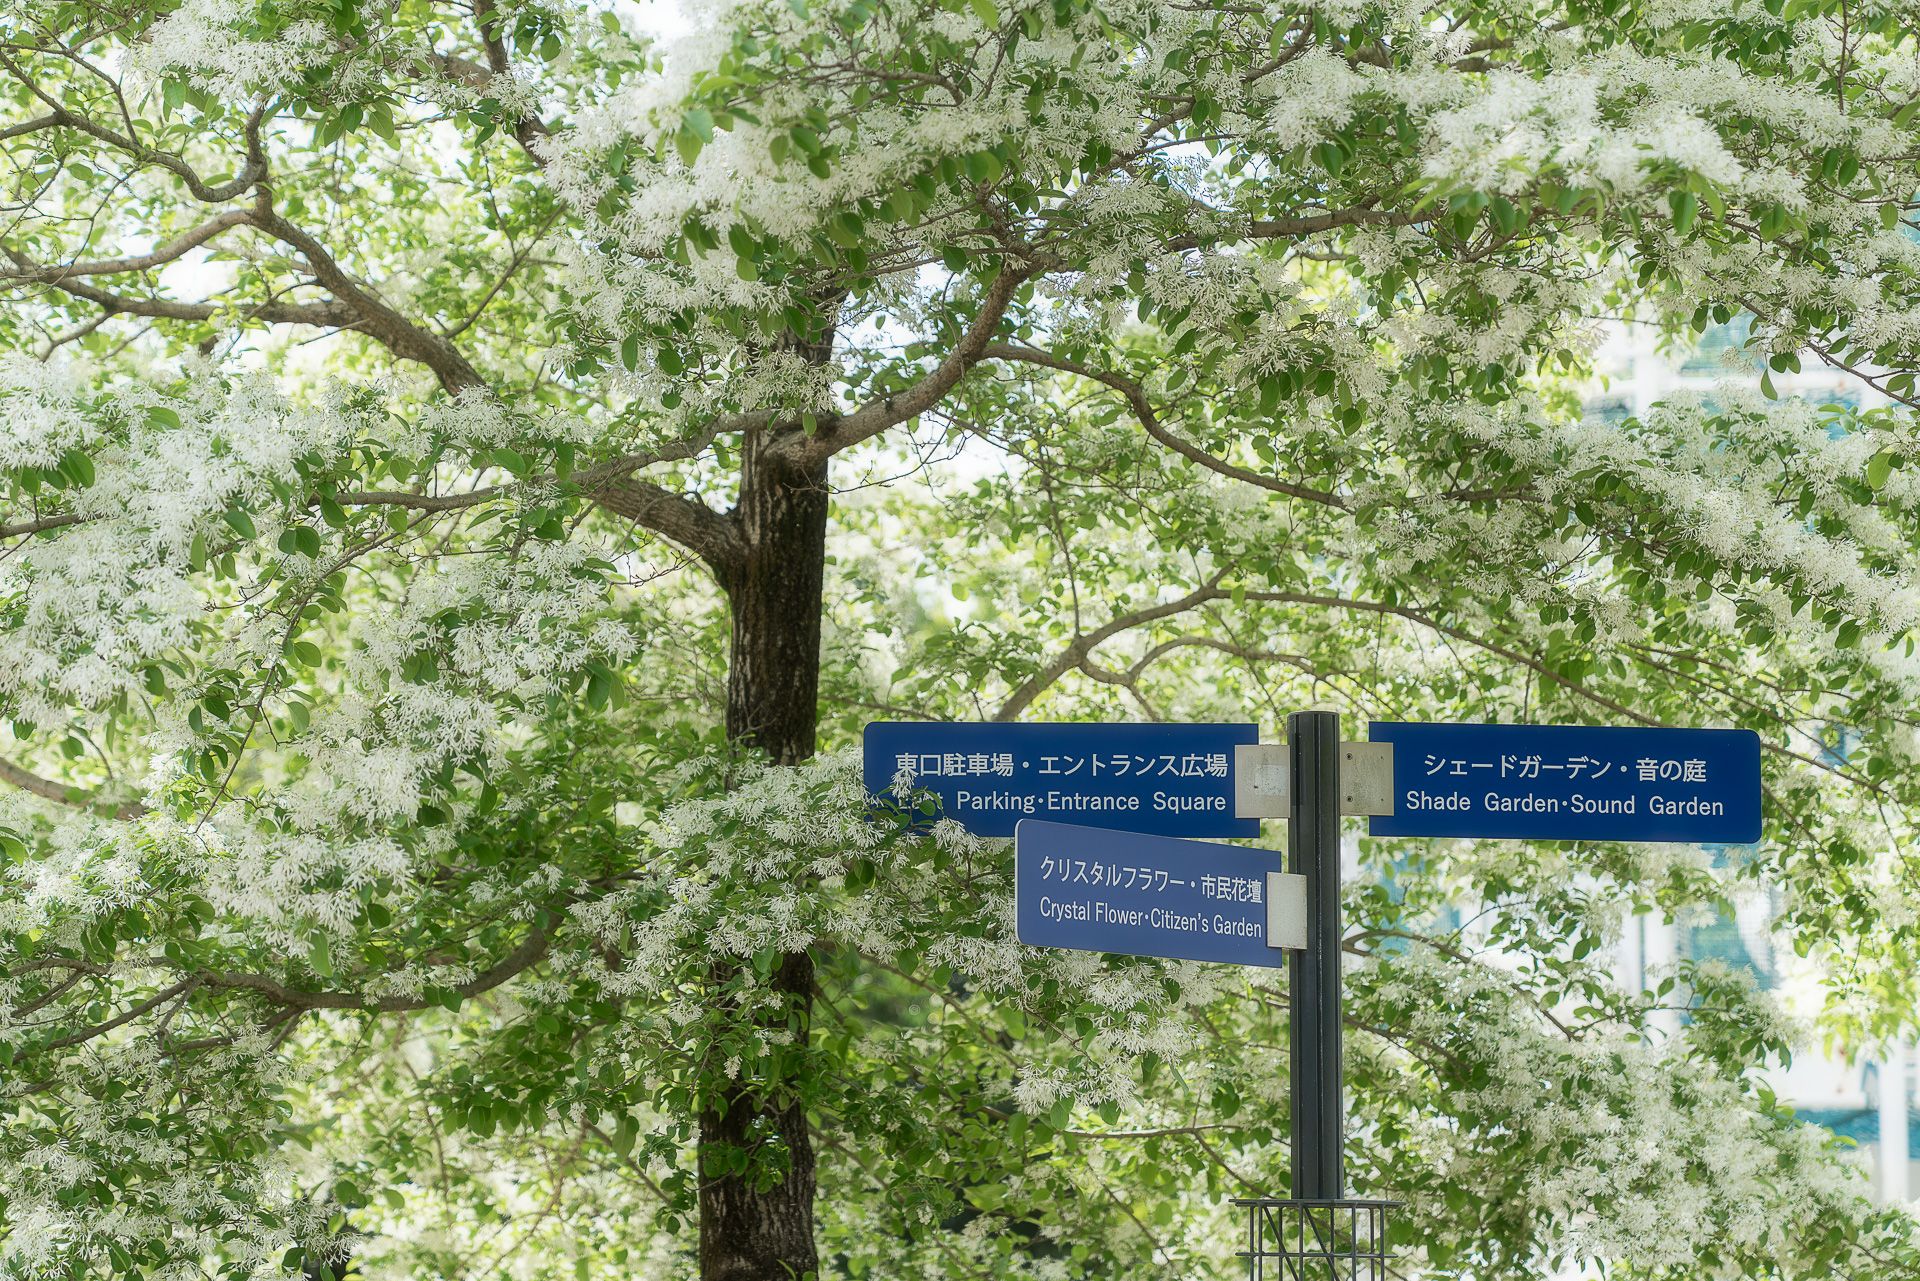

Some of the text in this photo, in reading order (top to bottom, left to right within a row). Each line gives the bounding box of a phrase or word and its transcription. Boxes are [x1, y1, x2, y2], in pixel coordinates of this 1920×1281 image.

[896, 752, 1228, 778] 東口駐車場・エントランス広場
[1424, 754, 1707, 782] シェードガーデン・音の庭
[1153, 791, 1226, 814] Square
[1406, 790, 1471, 811] Shade
[1649, 795, 1724, 816] Garden
[1040, 855, 1263, 904] クリスタルフラワー・市民花壇
[1040, 896, 1091, 923] Crystal
[1213, 914, 1262, 938] Garden
